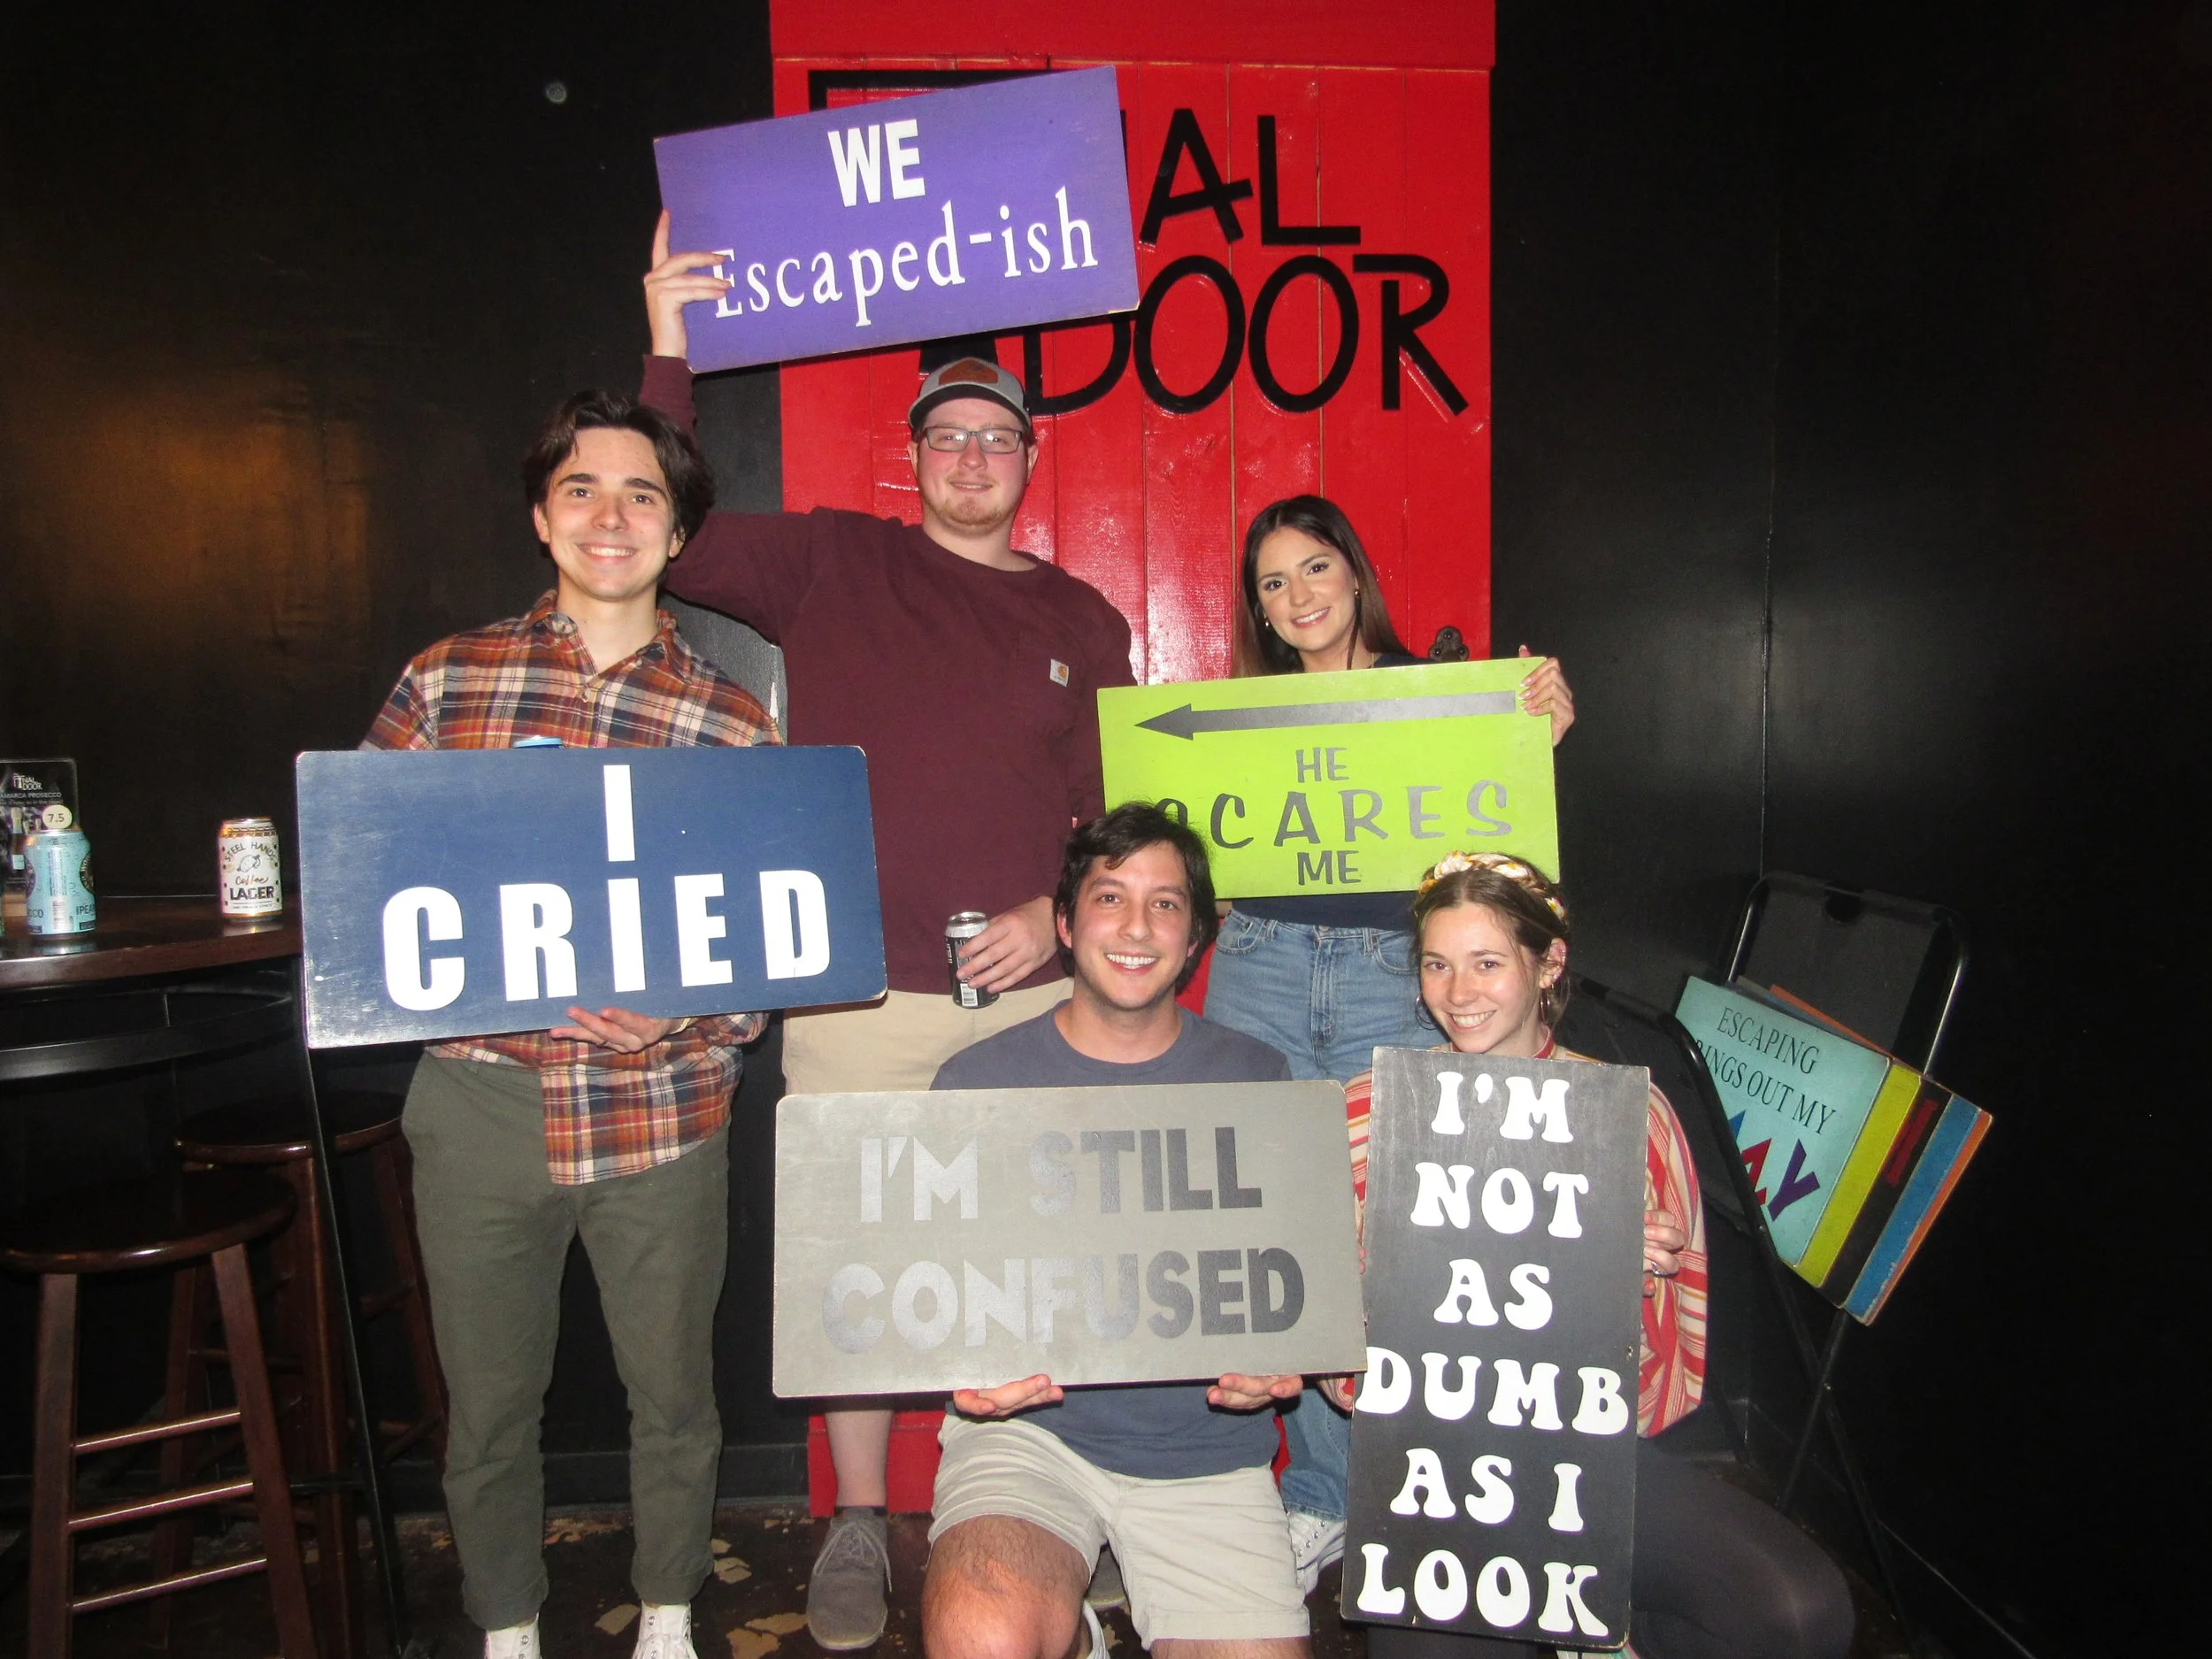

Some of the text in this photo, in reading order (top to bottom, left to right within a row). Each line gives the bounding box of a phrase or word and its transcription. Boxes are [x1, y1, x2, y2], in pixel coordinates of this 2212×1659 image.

[827, 119, 926, 208] WE
[711, 186, 1099, 327] Escaped-ish
[1295, 747, 1350, 783] HE
[48, 813, 65, 823] 7.5
[603, 764, 635, 862] I
[225, 841, 276, 862] STEEL HANDS
[235, 875, 269, 886] Coffee
[1297, 850, 1362, 886] ME
[230, 886, 275, 901] LAGER
[381, 870, 831, 1011] CRIED
[1717, 1007, 1820, 1074] ESCAPING
[1431, 1071, 1574, 1143] I'M
[1747, 1070, 1794, 1113] OUT
[1792, 1094, 1836, 1135] MY
[860, 1126, 1263, 1223] I'M STILL
[1409, 1162, 1589, 1239] NOT
[821, 1247, 1305, 1355] CONFUSED
[1432, 1258, 1553, 1331] AS
[1355, 1346, 1629, 1435] DUMB
[1389, 1448, 1584, 1532] AS I
[1356, 1542, 1609, 1637] LOOK
